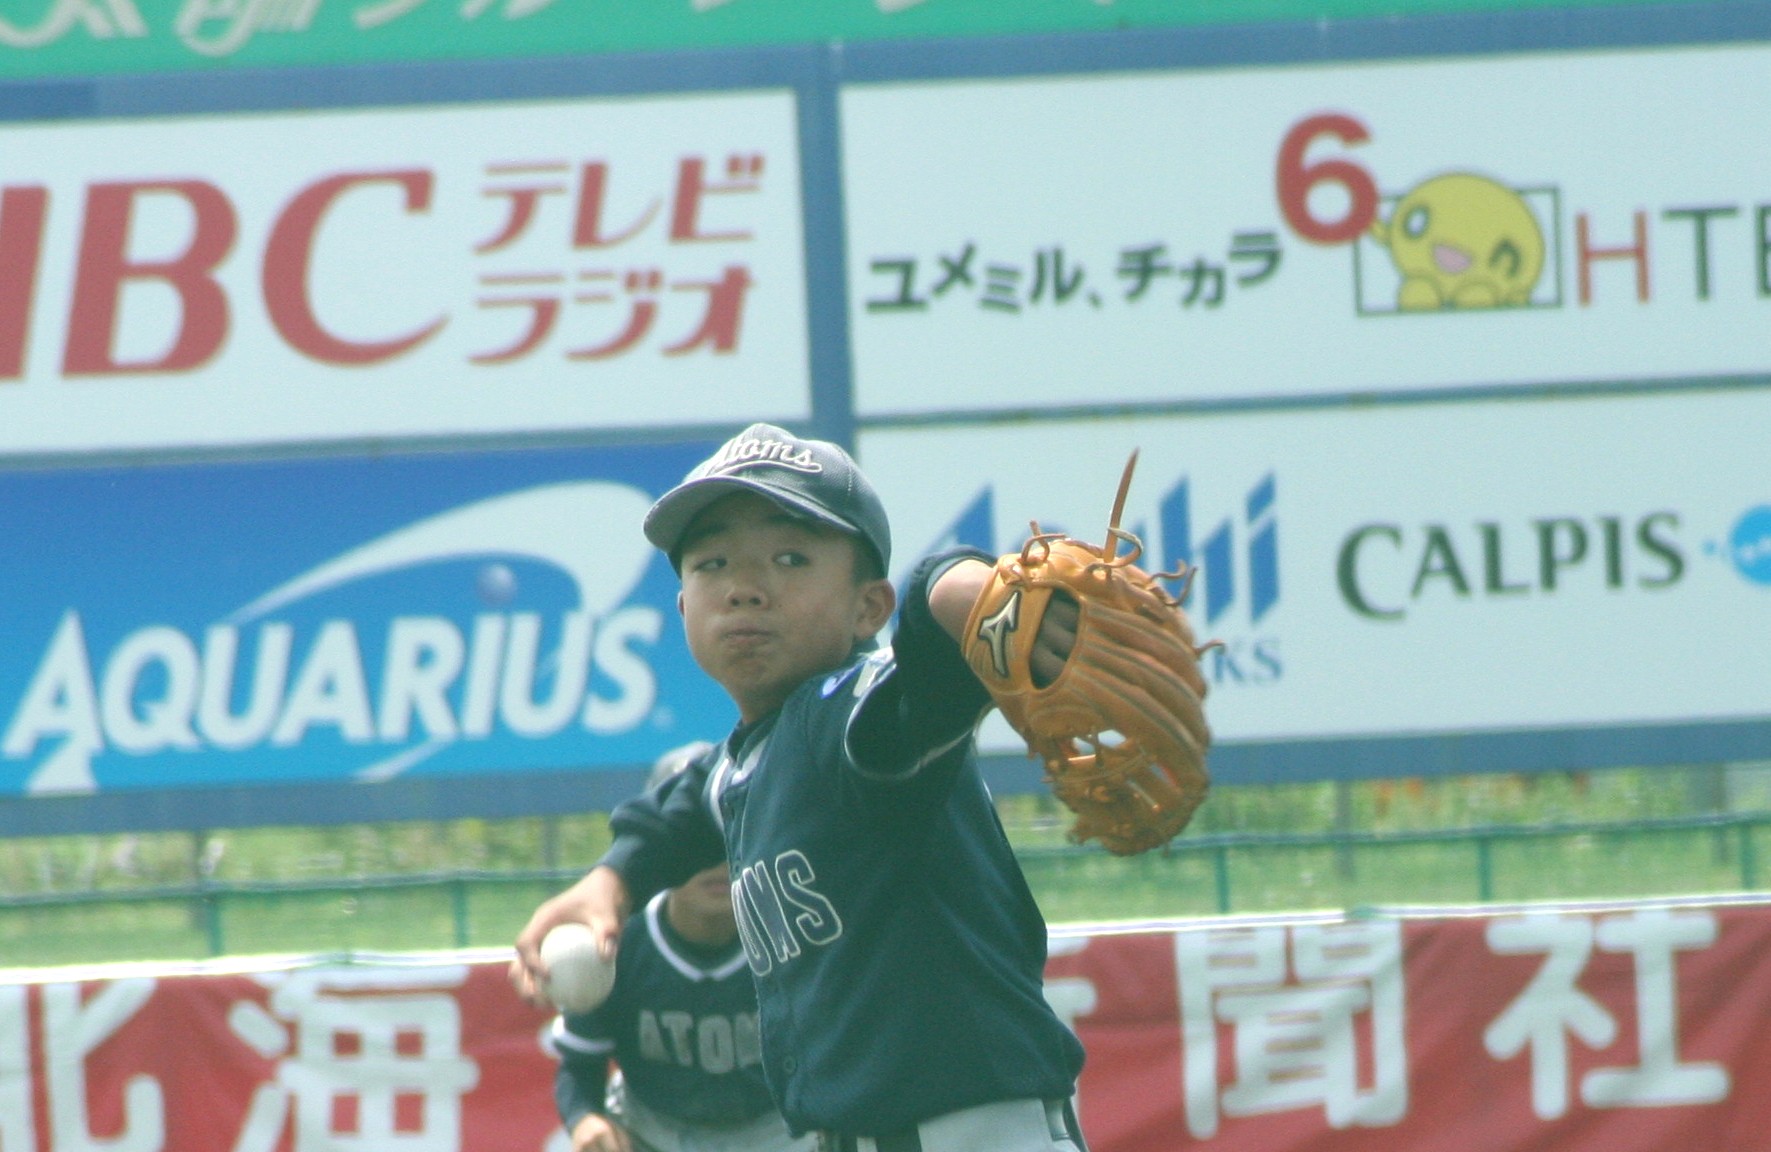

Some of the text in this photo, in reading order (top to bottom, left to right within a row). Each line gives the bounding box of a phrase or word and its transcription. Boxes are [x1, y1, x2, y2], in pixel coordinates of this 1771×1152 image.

[474, 154, 764, 255] テレビ
[1275, 111, 1379, 245] 6
[1575, 206, 1771, 306] HT
[467, 267, 757, 367] ラジオ
[1336, 511, 1687, 621] CALPIS
[3, 605, 665, 796] AQUARIUS
